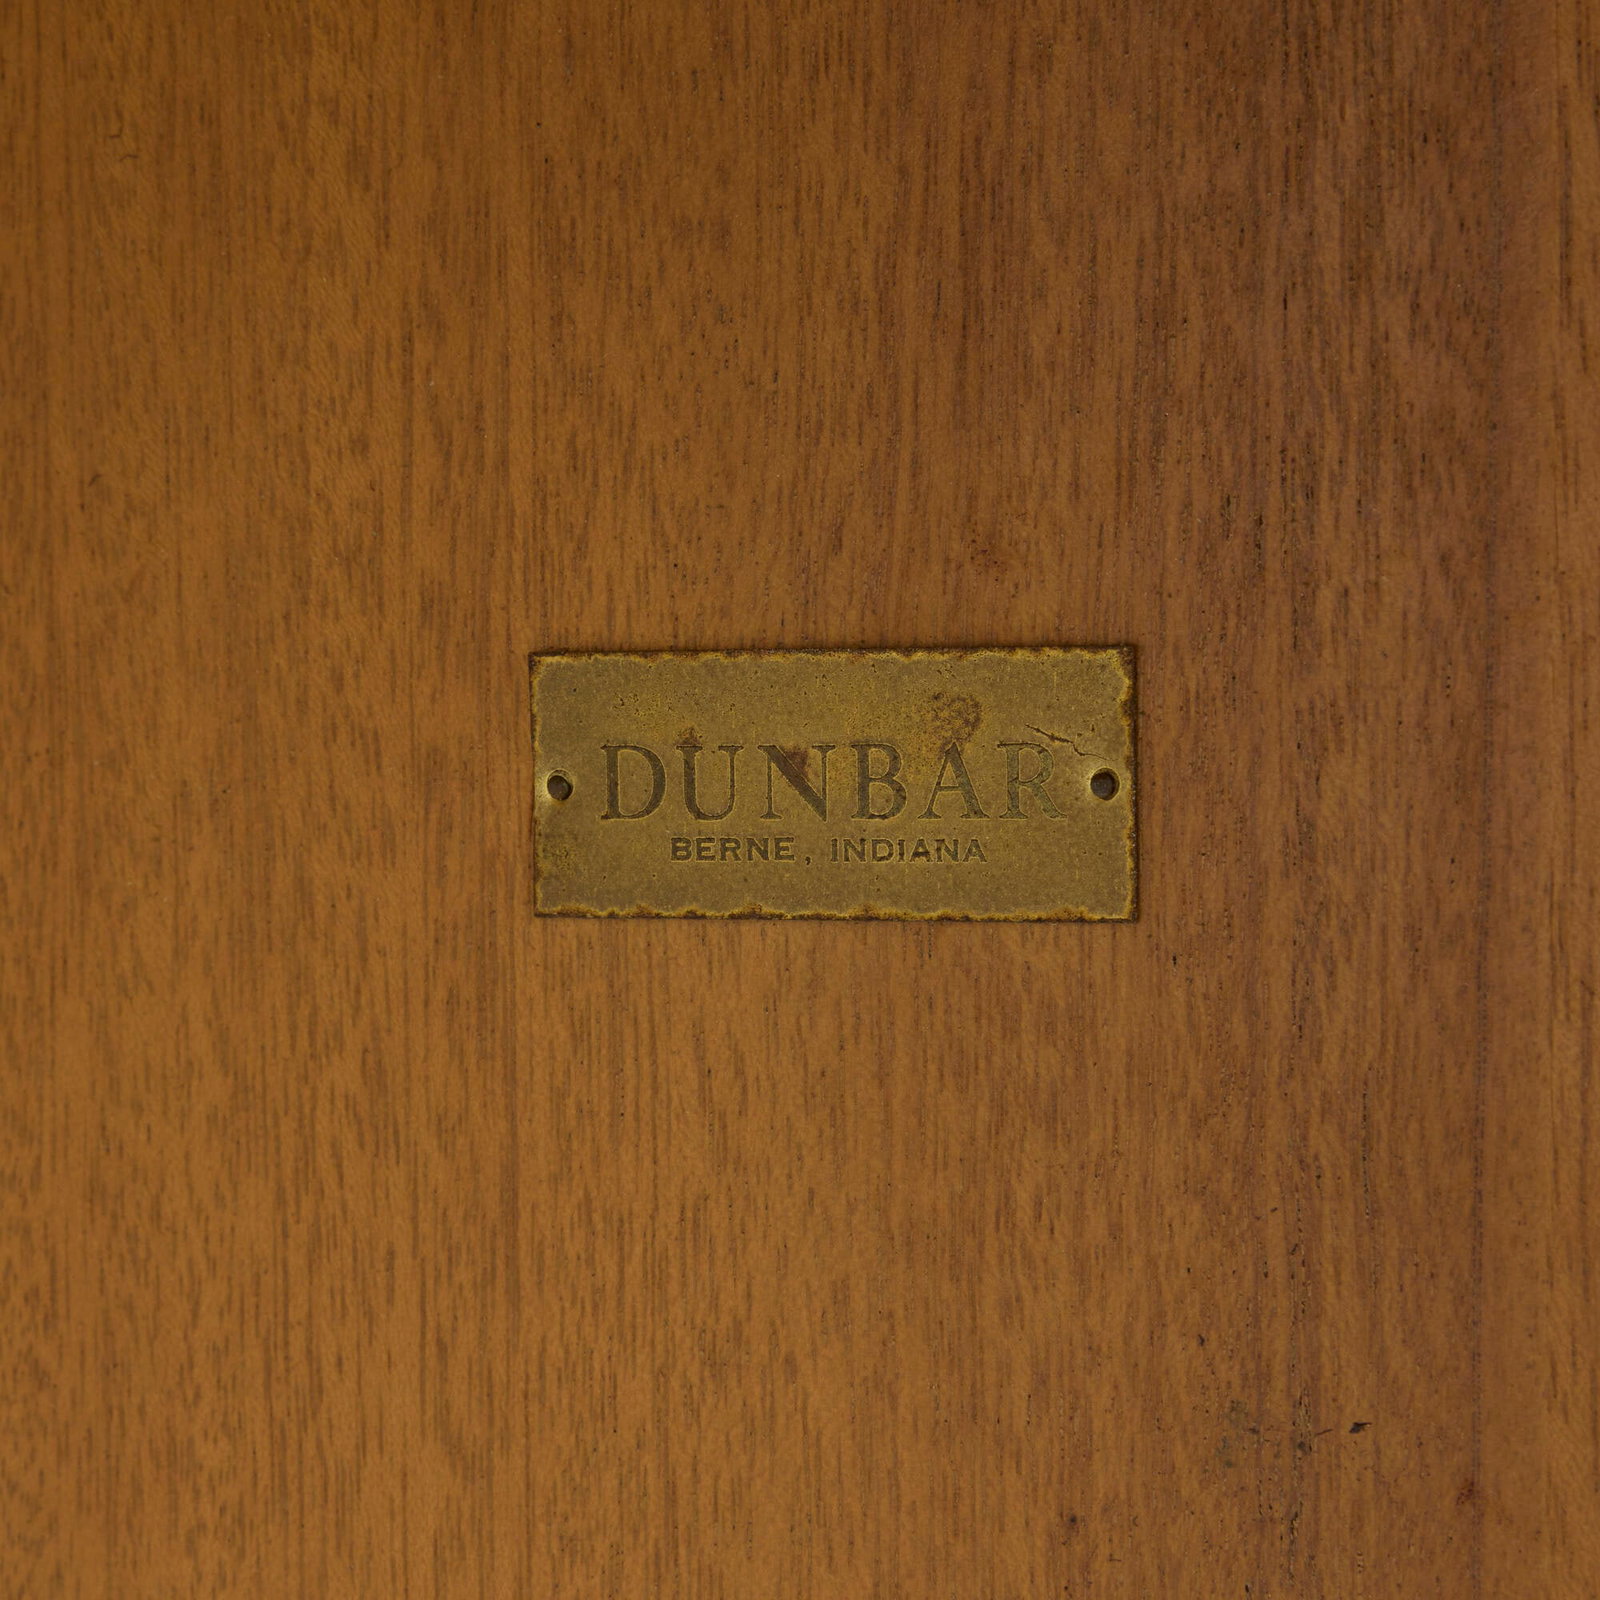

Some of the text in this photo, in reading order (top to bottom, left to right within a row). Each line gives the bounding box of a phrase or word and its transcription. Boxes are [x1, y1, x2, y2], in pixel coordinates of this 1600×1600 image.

[600, 742, 1068, 821] DUNBAR
[670, 837, 988, 866] BERNE, INDIANA
